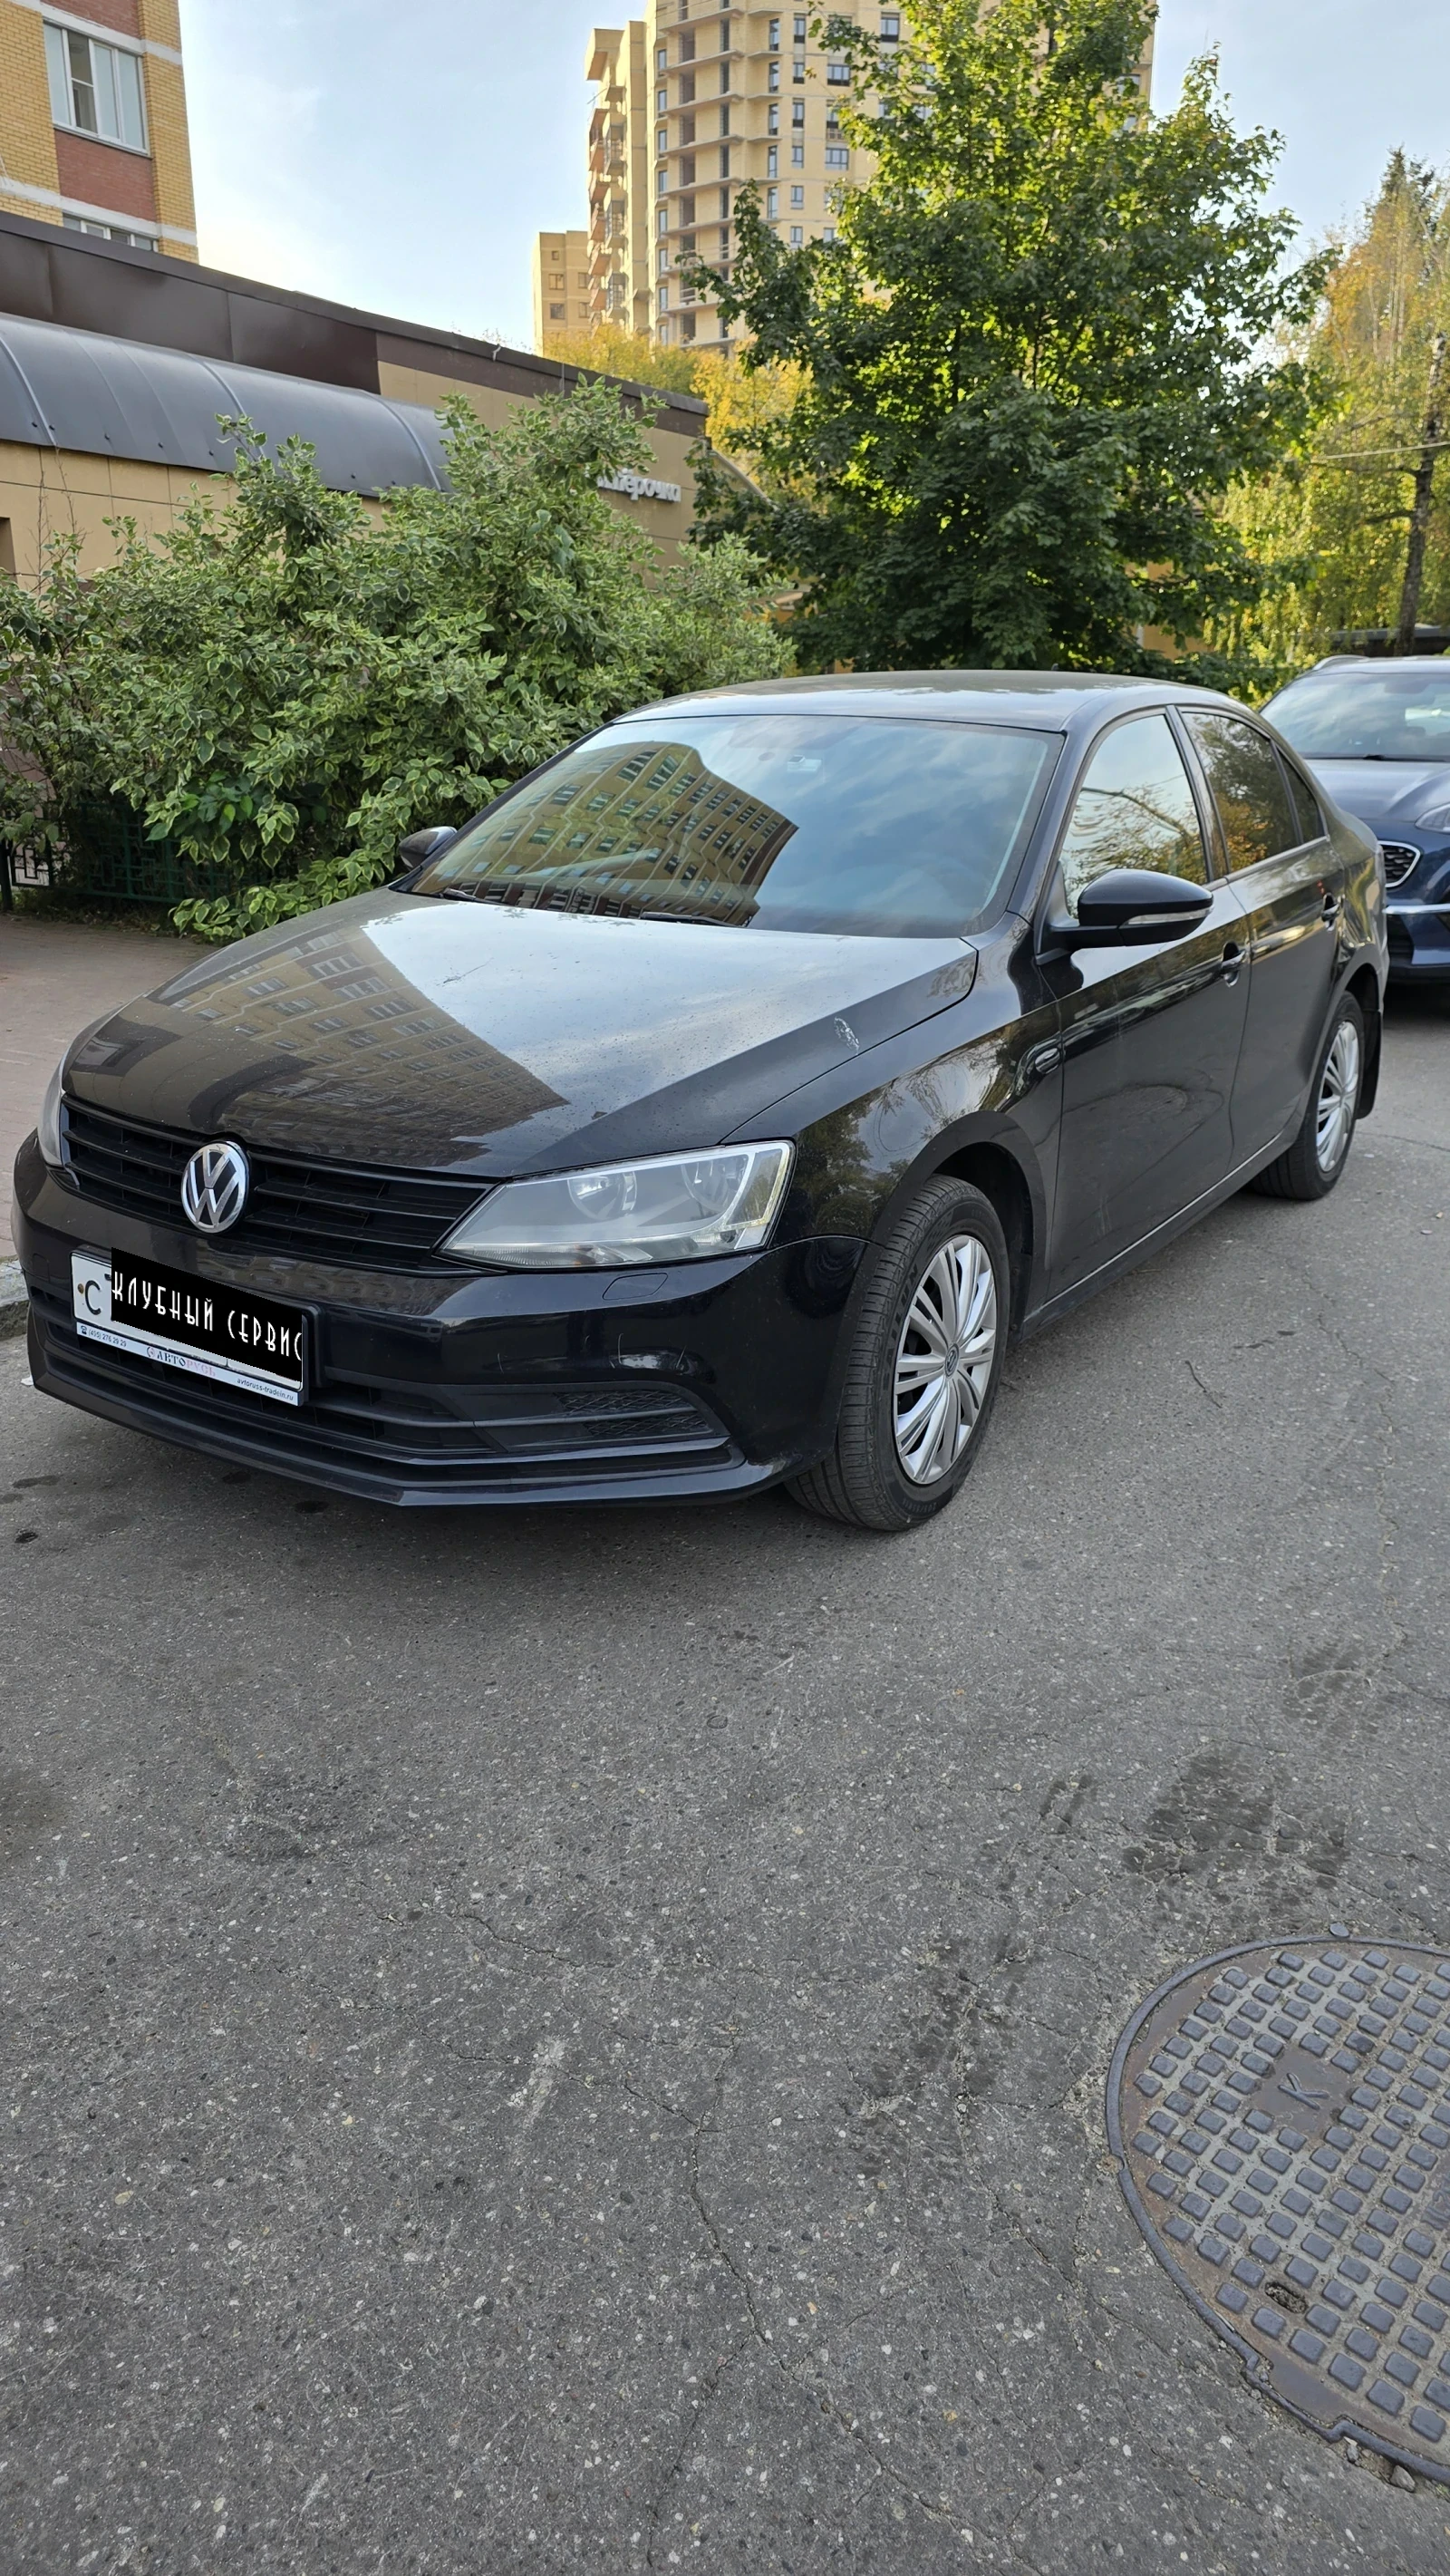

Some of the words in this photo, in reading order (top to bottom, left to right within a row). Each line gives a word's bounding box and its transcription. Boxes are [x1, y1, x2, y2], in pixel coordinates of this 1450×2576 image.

[597, 468, 682, 502] ятёрочка
[157, 1351, 217, 1377] АВТОРУСЬ
[237, 1377, 295, 1401] avtoruss-tradein.ru
